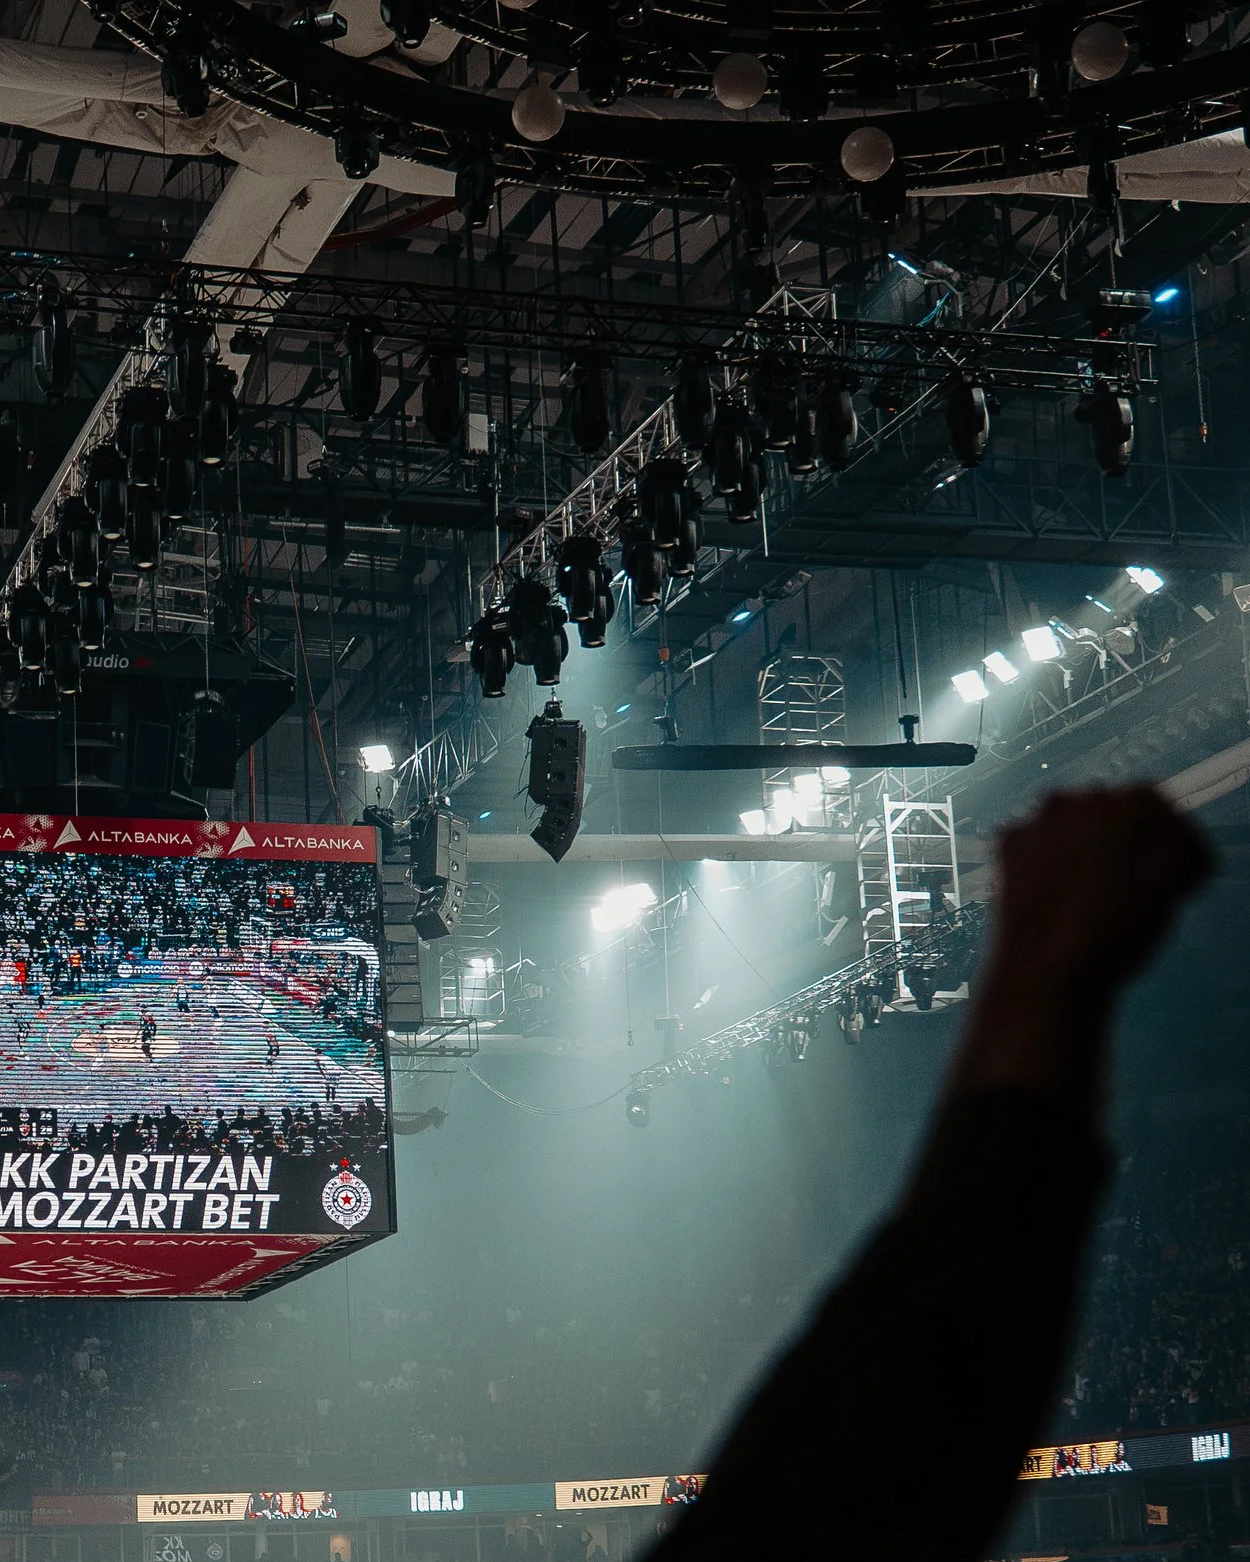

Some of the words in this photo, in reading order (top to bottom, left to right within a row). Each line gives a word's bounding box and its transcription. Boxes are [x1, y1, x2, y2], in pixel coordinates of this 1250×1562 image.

[88, 830, 193, 845] ALTABANKA
[262, 836, 365, 850] ALTABANKA
[0, 1152, 61, 1189] KK
[68, 1154, 274, 1191] PARTIZAN
[202, 1194, 281, 1230] BET
[571, 1483, 651, 1503] MOZZART
[152, 1496, 235, 1516] MOZZART
